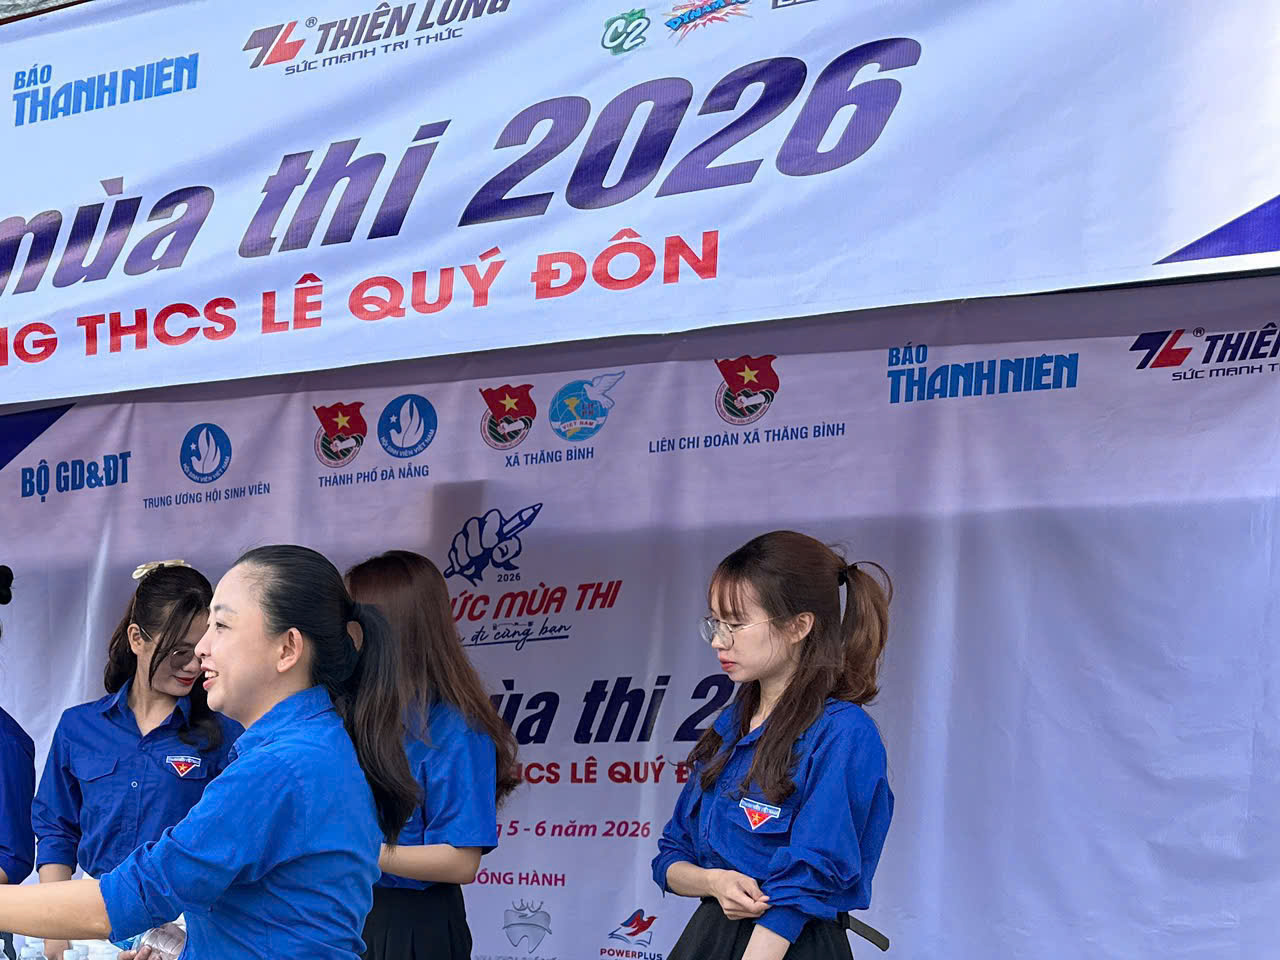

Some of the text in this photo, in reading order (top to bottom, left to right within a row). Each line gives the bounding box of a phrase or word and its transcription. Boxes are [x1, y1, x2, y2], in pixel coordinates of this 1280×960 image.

[315, 2, 416, 55] THIÊN
[664, 0, 750, 31] DYNAM
[602, 17, 651, 49] C2
[285, 60, 318, 75] SỨC
[380, 40, 408, 54] TRI
[414, 27, 463, 47] THỨC
[13, 63, 52, 91] BÁO
[238, 119, 451, 258] thi
[458, 37, 922, 227] 2026
[77, 297, 237, 356] THCS
[262, 273, 324, 334] LÊ
[348, 246, 508, 322] QUÝ
[530, 227, 719, 300] ĐÔN
[888, 342, 928, 367] BÁO
[1172, 368, 1205, 381] SỨC
[649, 421, 846, 454] LIÊN CHI ĐOÀN XÃ THĂNG BÌNH
[505, 446, 594, 467] XÃ THĂNG BÌNH
[21, 451, 132, 503] BỘ GD&ĐT
[318, 462, 429, 488] THÀNH PHỐ ĐÀ NẴNG
[143, 481, 270, 509] TRUNG ƯƠNG HỘI SINH VIÊN
[497, 572, 521, 582] 2026
[450, 580, 623, 623] ỨC MÙA THI
[539, 617, 572, 637] bạn
[573, 675, 672, 744] thi
[571, 756, 597, 784] LÊ
[608, 755, 666, 784] QUÝ
[507, 820, 519, 836] 5
[535, 820, 547, 837] 6
[551, 820, 597, 837] năm
[602, 820, 651, 838] 2026
[471, 868, 565, 887] ỒNG HÀNH
[600, 948, 663, 960] POWERPLUS
